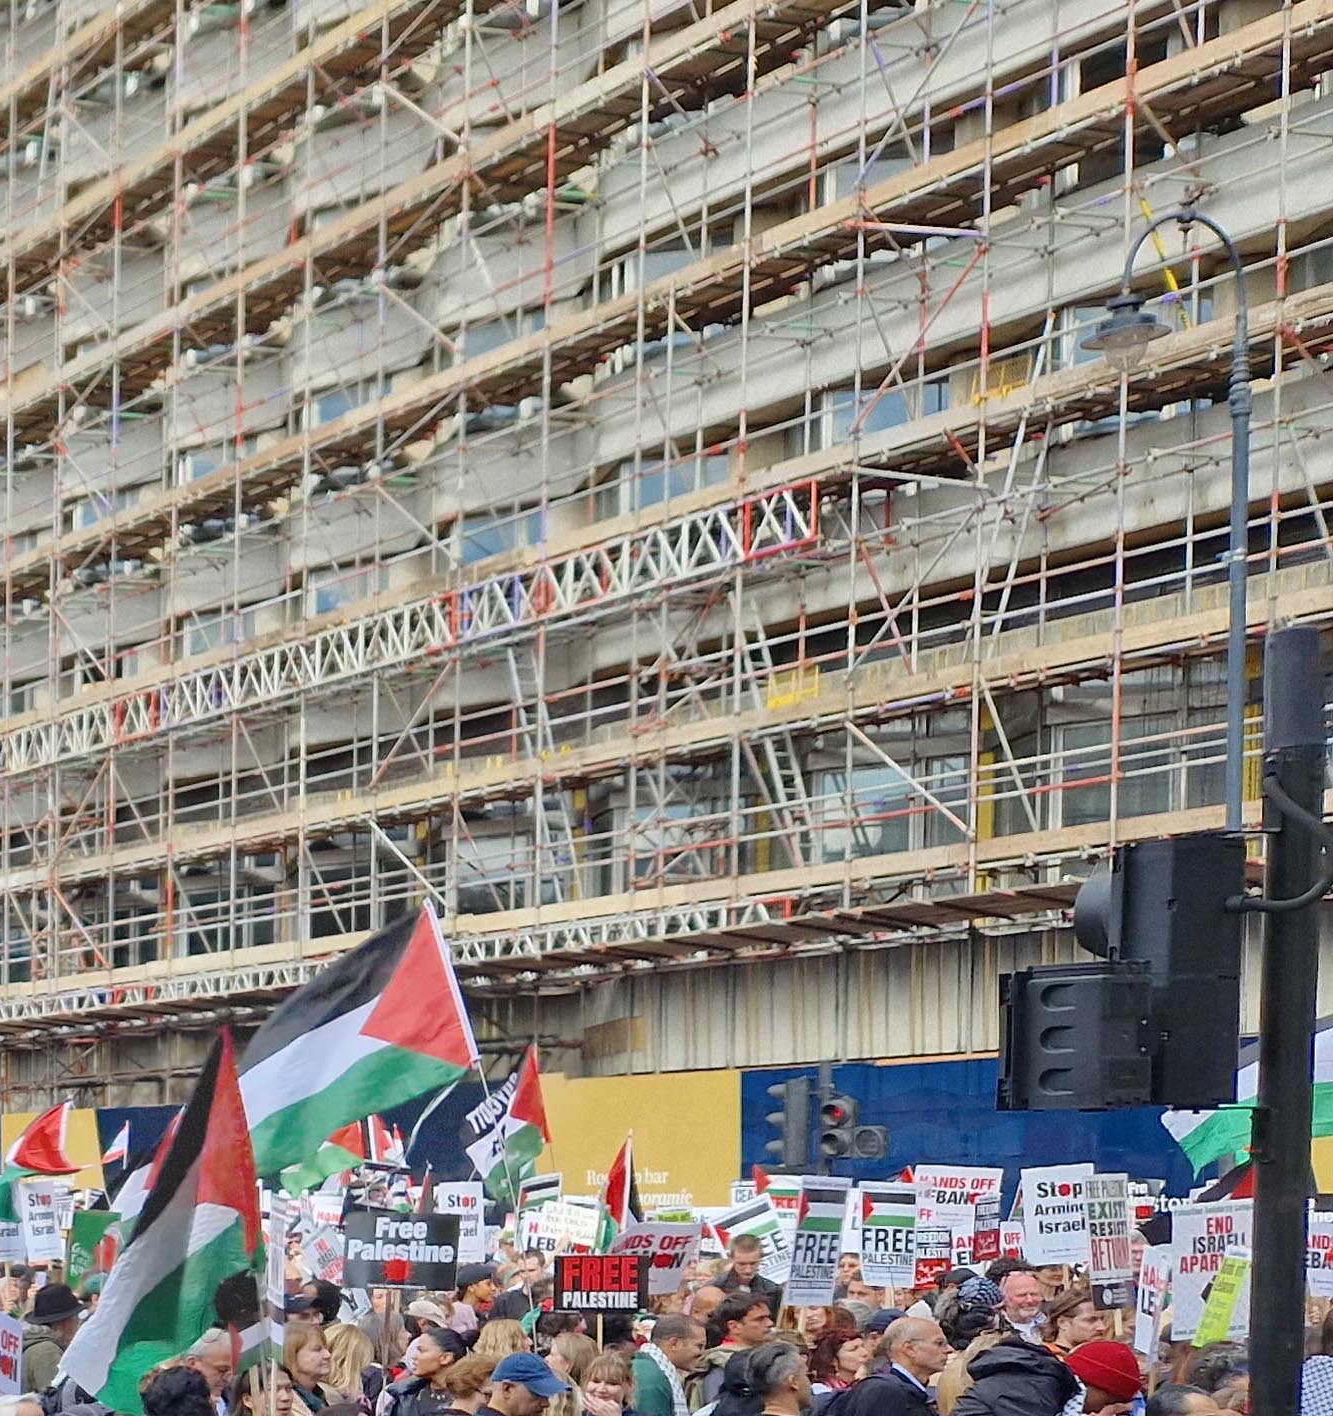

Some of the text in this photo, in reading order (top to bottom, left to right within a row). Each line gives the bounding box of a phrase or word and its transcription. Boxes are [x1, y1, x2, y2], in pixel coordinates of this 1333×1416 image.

[644, 1169, 669, 1185] bar
[971, 1178, 996, 1190] OFF
[1085, 1180, 1100, 1199] FREE
[375, 1217, 428, 1240] Free
[1039, 1217, 1086, 1234] Israel
[1206, 1216, 1233, 1235] END
[659, 1234, 693, 1250] OFF
[862, 1228, 915, 1253] FREE
[1004, 1232, 1021, 1245] OFF
[347, 1239, 455, 1263] Palestine
[792, 1232, 840, 1264] FREE
[862, 1252, 914, 1266] PALESTINE
[562, 1256, 639, 1291] FREE
[790, 1264, 835, 1279] PALESTINE
[562, 1291, 638, 1309] PALESTINE
[1, 1329, 19, 1355] OFF
